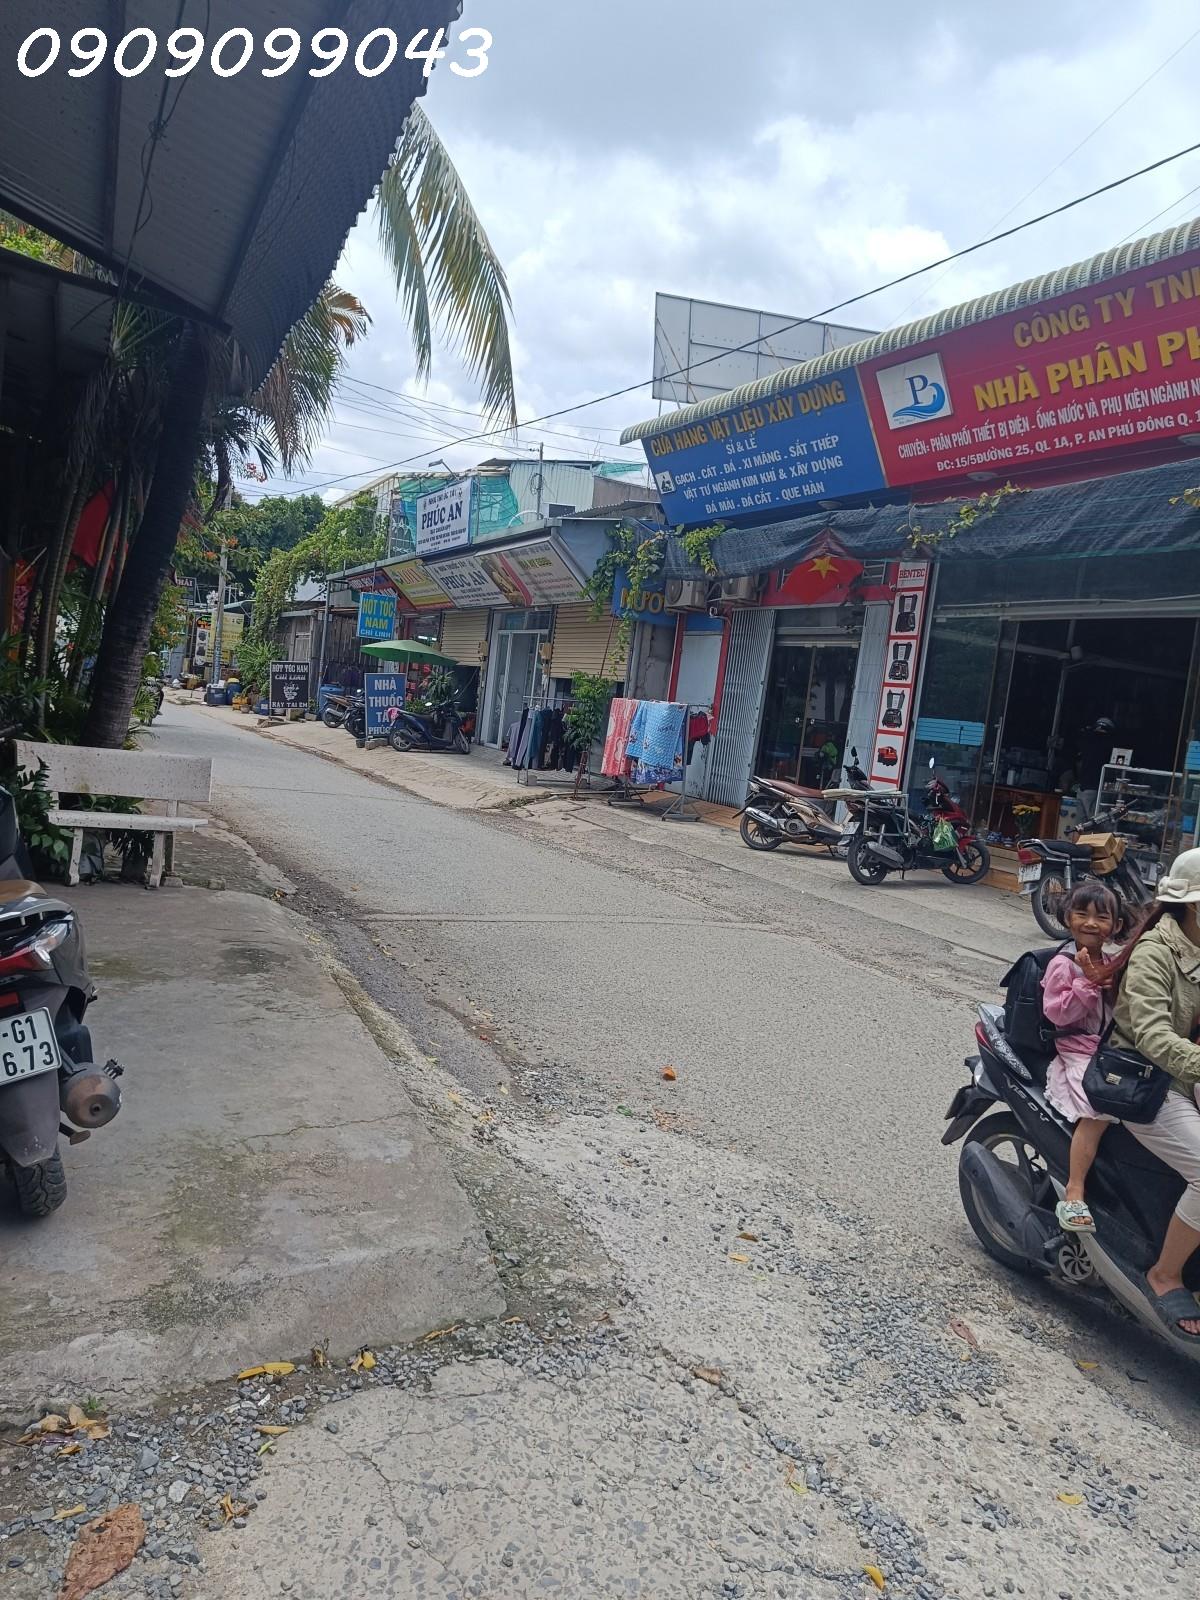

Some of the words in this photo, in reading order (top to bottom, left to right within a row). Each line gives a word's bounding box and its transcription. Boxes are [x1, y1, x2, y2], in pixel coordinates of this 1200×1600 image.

[1013, 312, 1091, 348] CÔNG
[1094, 287, 1136, 323] TY
[973, 364, 1039, 412] NHÀ
[1046, 341, 1148, 393] PHÂN
[798, 379, 846, 417] DỰNG
[898, 438, 930, 459] CHUYÊN:
[930, 432, 952, 453] PHÂN
[952, 424, 972, 447] PHỐI
[972, 418, 996, 443] THIẾT
[998, 420, 1009, 440] BỊ
[1008, 413, 1031, 437] ĐIỆN
[1036, 406, 1057, 430] ỐNG
[1057, 399, 1085, 425] NƯỚC
[1085, 397, 1099, 419] VÀ
[1100, 395, 1123, 417] PHỤ
[1124, 387, 1150, 412] KIỆN
[1150, 380, 1190, 406] NGÀNH
[1035, 440, 1051, 454] QL
[1088, 428, 1106, 442] AN
[1107, 418, 1134, 439] PHÚ
[1136, 415, 1175, 434] ĐÔNG
[674, 471, 697, 487] GẠCH
[701, 464, 718, 480] CÁT
[723, 459, 737, 474] ĐÁ
[742, 457, 753, 471] XI
[753, 451, 782, 468] MĂNG
[789, 439, 808, 458] SẮT
[810, 432, 840, 453] THÉP
[683, 487, 698, 503] VẬT
[699, 483, 711, 498] TƯ
[712, 478, 741, 495] NGÀNH
[741, 474, 759, 489] KIM
[760, 467, 777, 484] KHÍ
[811, 455, 844, 475] DỰNG
[705, 499, 718, 514] ĐÁ
[741, 492, 754, 507] ĐÁ
[754, 487, 772, 505] CẮT
[781, 486, 802, 502] QUE
[802, 480, 825, 497] HÀN
[421, 503, 446, 530] PHÚC
[447, 500, 463, 522] AN
[440, 571, 472, 590] PHÚC
[468, 570, 489, 586] AN
[365, 617, 388, 630] NAM
[368, 691, 404, 708] THUỐC
[374, 676, 397, 690] NHÀ
